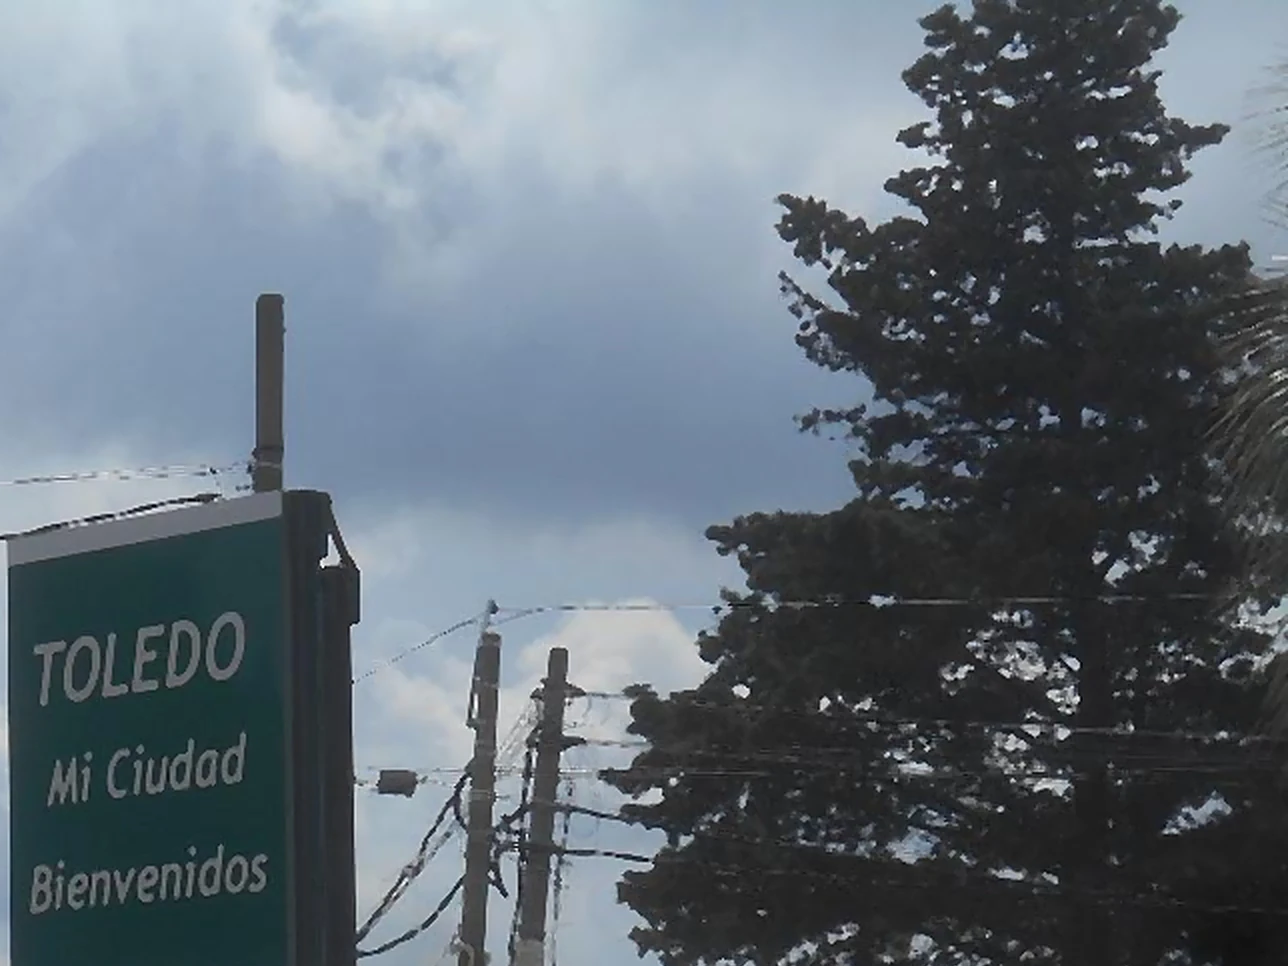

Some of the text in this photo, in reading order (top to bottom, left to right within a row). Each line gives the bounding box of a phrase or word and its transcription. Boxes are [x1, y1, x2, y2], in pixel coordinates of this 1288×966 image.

[34, 611, 246, 706] TOLEDO
[47, 732, 247, 807] Mi Ciudad
[29, 844, 269, 914] Bienvenidos
